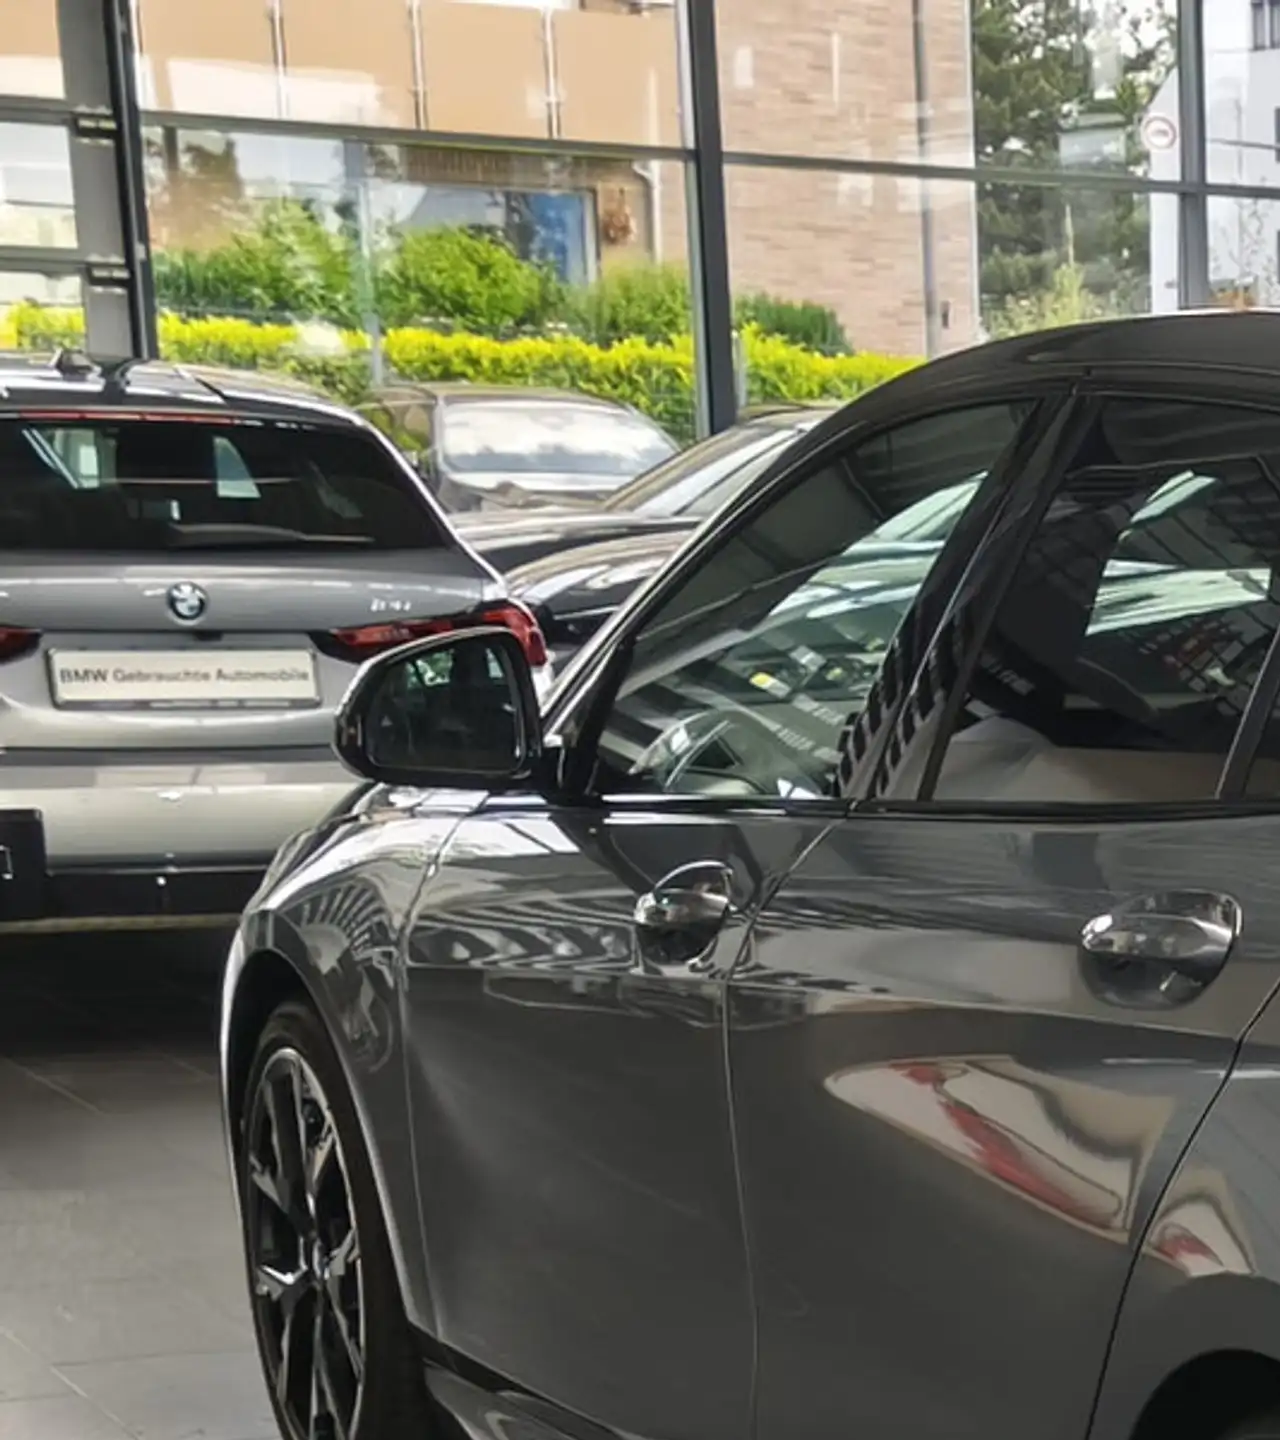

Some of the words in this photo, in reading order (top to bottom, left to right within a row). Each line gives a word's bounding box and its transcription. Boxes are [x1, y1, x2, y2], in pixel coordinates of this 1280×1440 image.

[60, 668, 108, 684] BMW
[113, 668, 211, 683] Gebrauchte
[216, 667, 309, 682] Automobile
